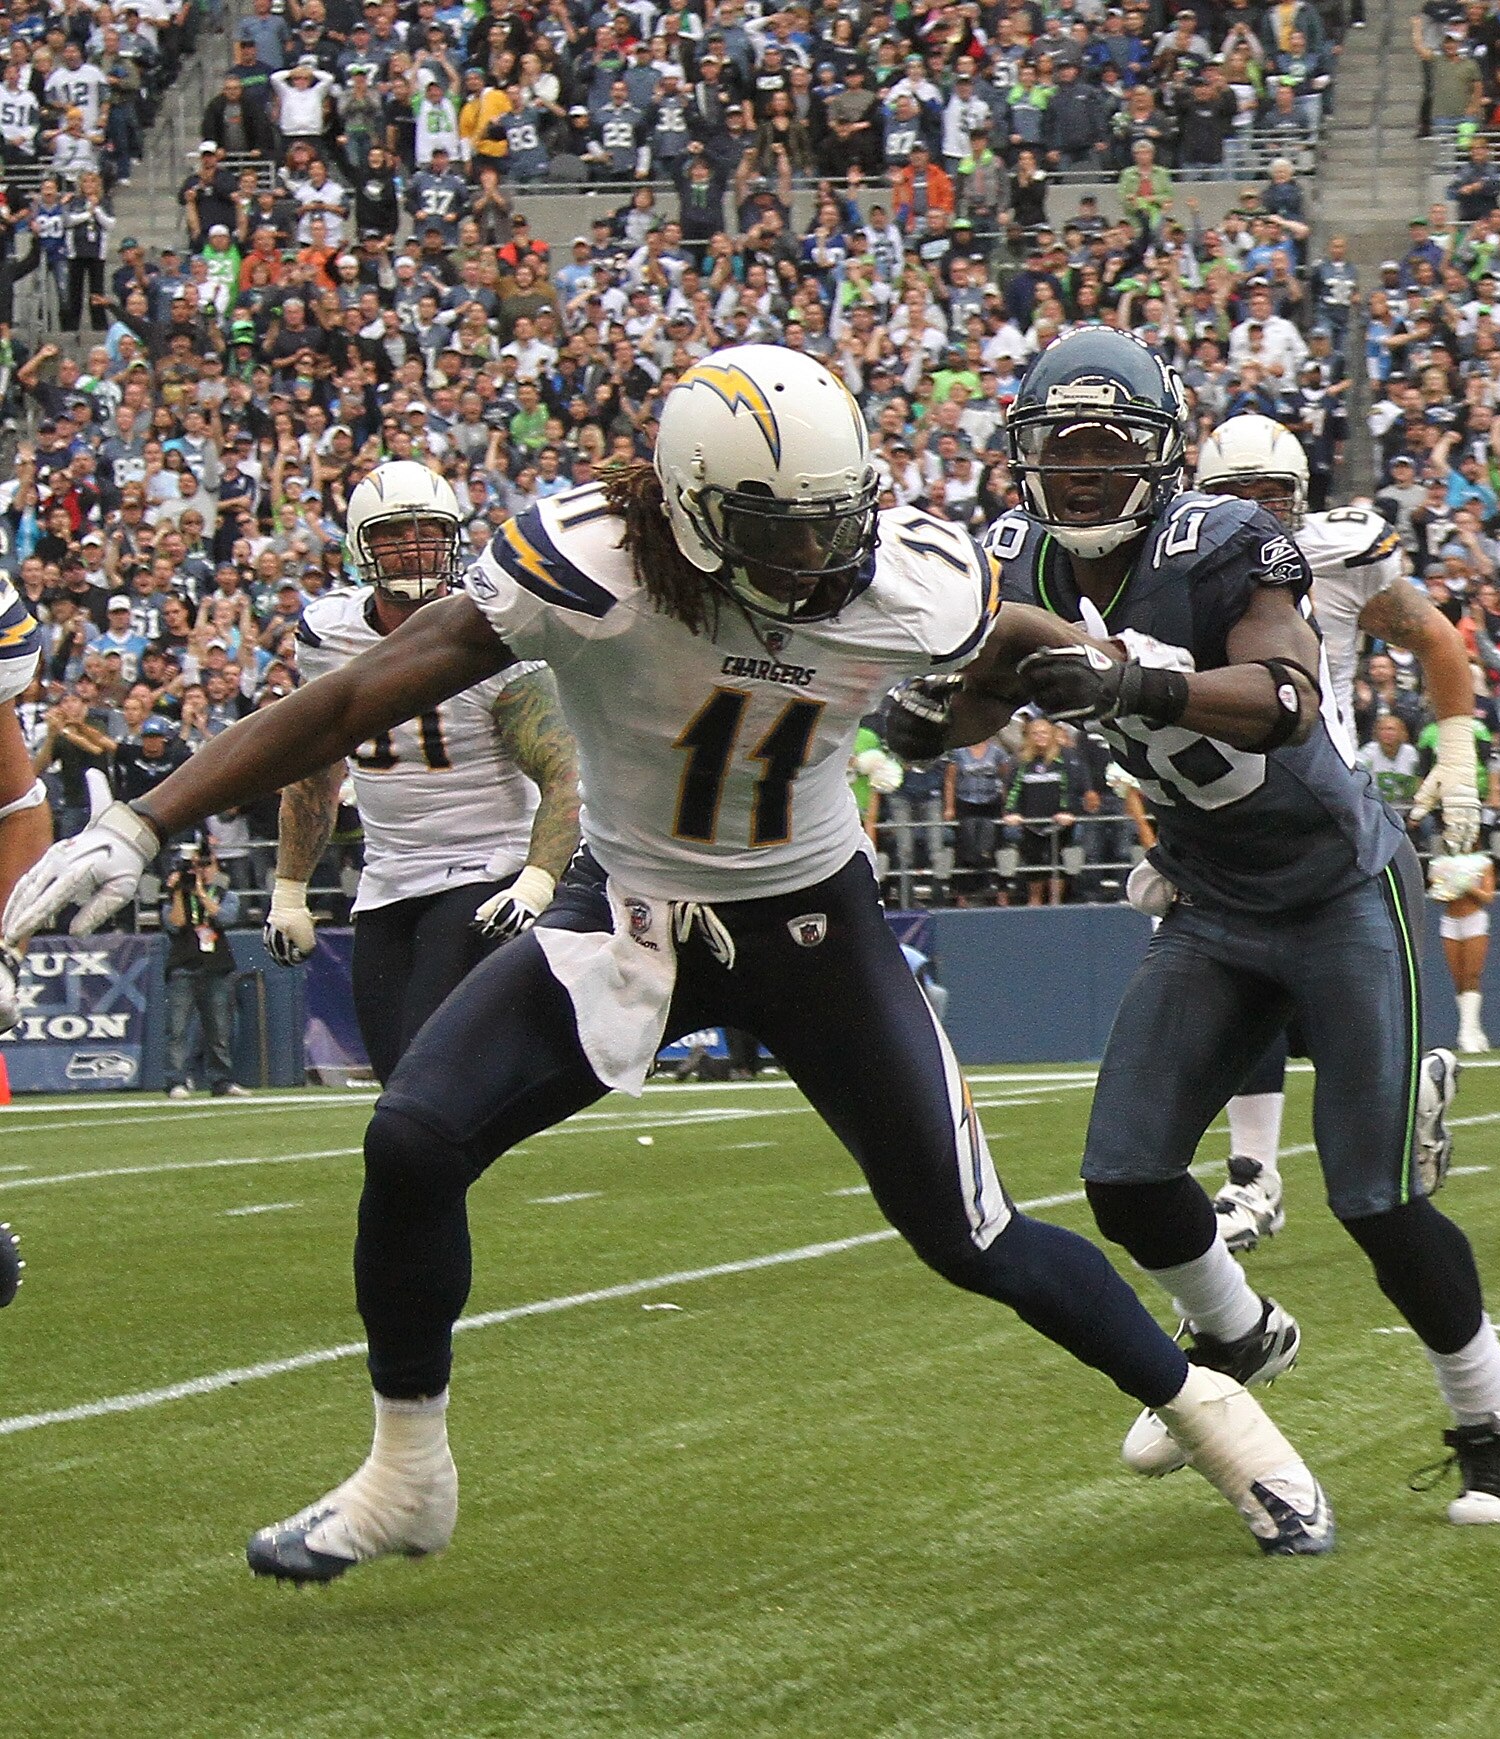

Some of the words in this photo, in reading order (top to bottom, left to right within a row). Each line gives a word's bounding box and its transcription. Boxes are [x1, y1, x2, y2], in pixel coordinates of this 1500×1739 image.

[421, 189, 455, 215] 37
[720, 655, 818, 686] CHARGERS
[671, 685, 827, 847] 11
